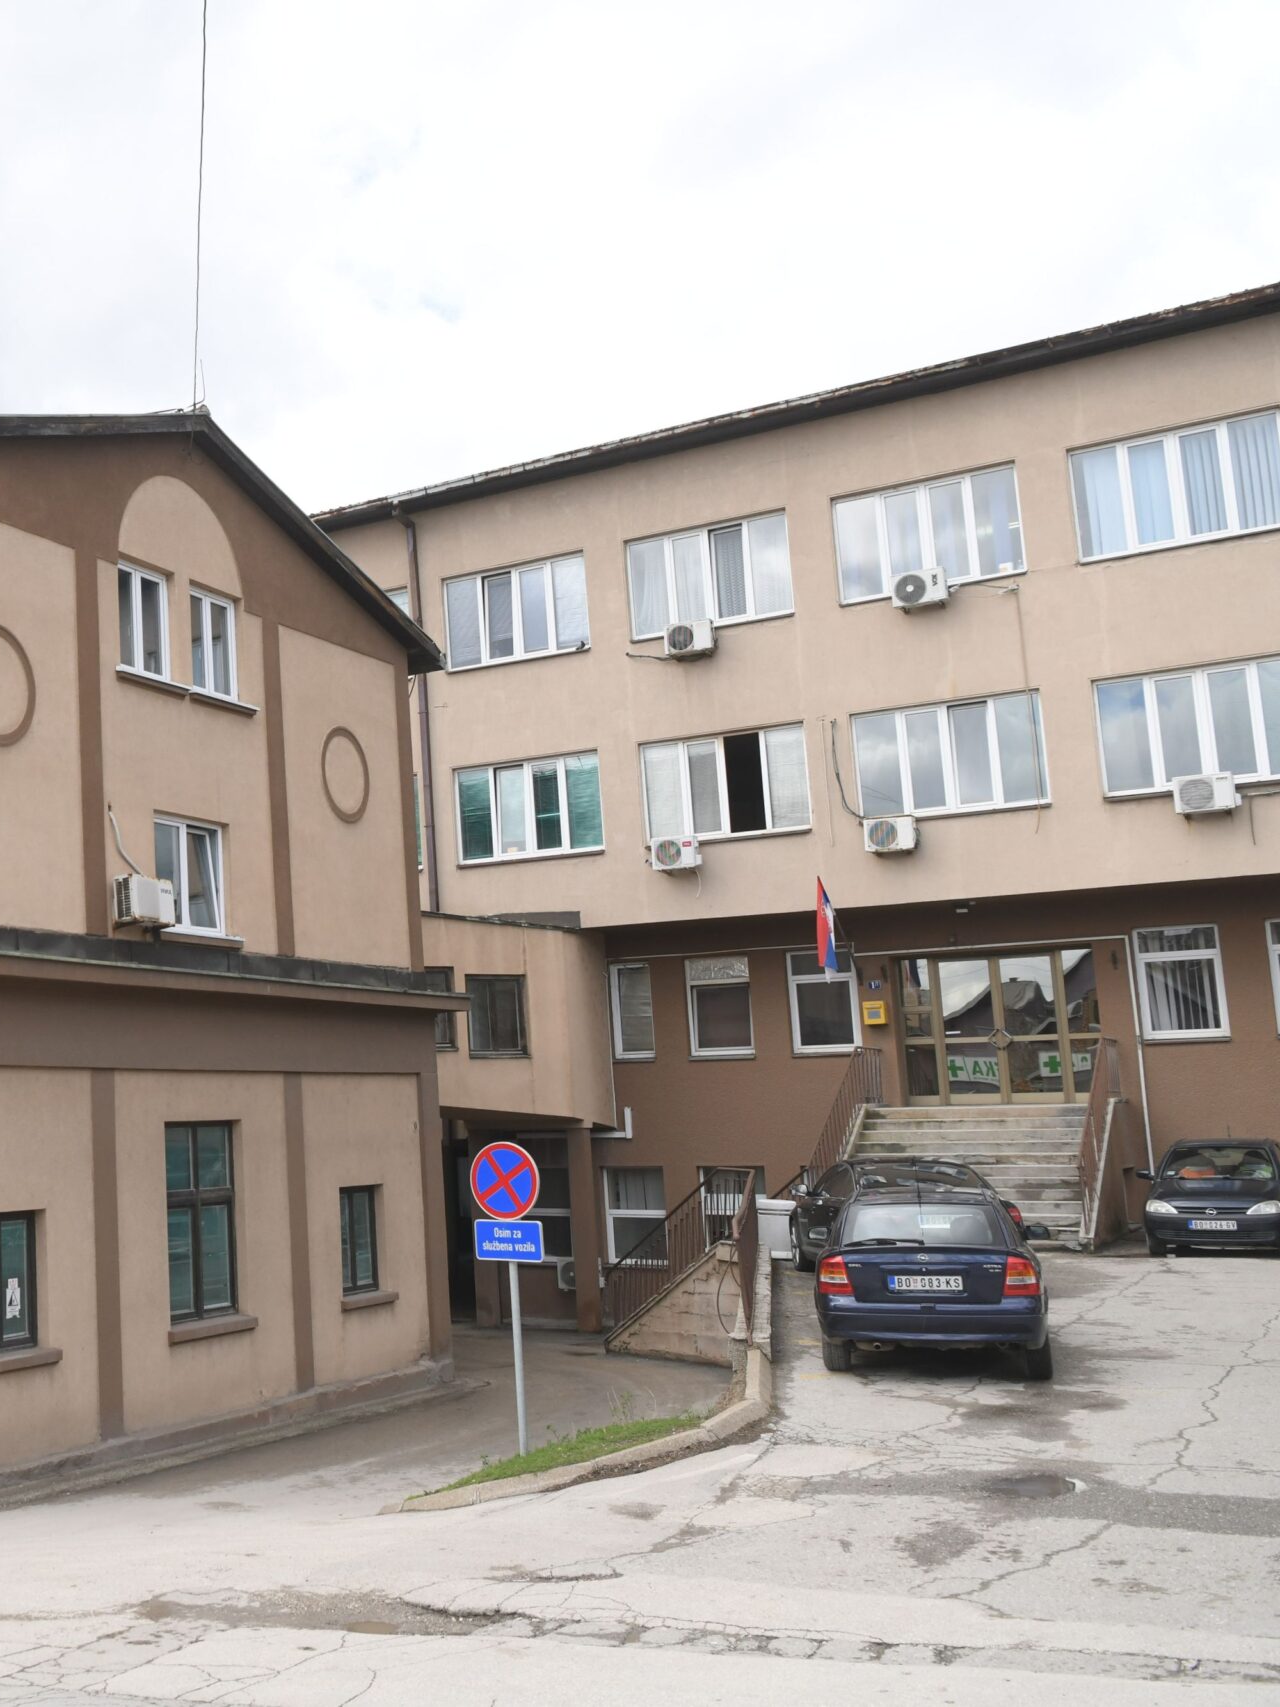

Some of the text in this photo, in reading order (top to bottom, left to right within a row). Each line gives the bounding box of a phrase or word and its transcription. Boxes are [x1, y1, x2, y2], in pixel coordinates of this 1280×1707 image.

[493, 1227, 522, 1238] Osim za
[482, 1240, 536, 1252] službena vozila
[897, 1277, 911, 1288] BO
